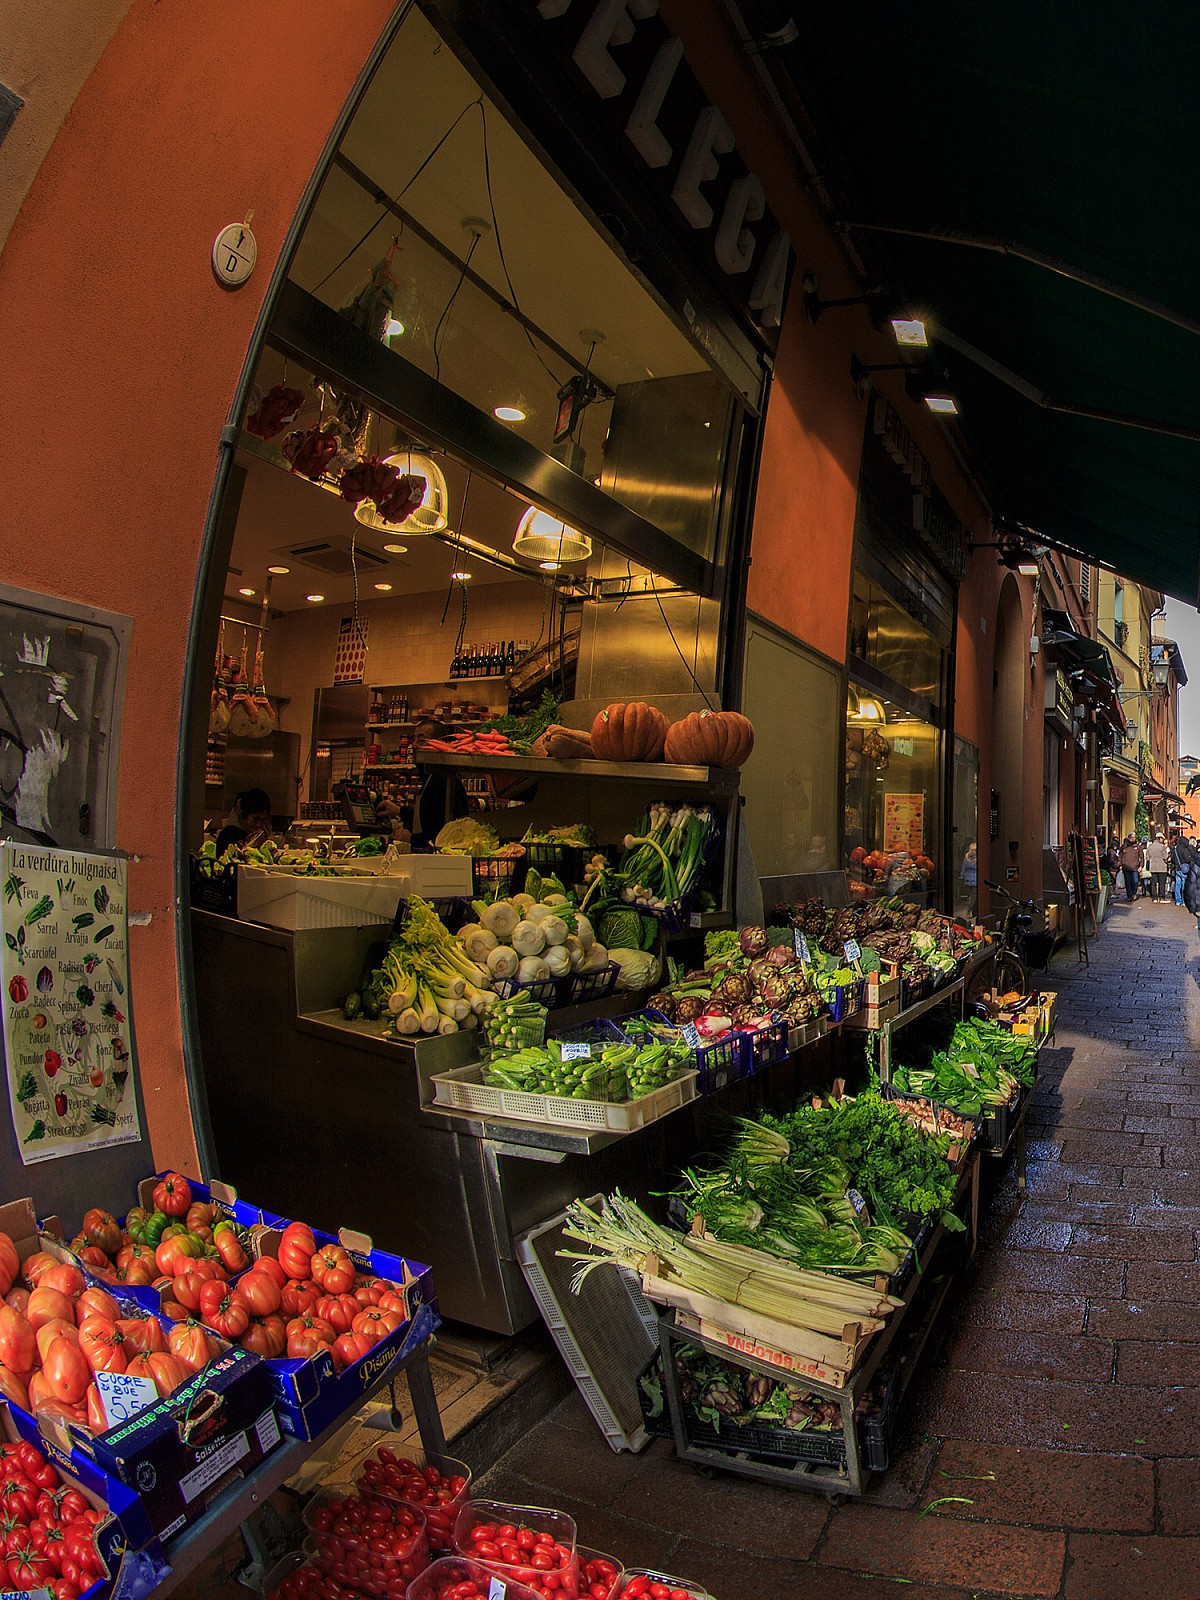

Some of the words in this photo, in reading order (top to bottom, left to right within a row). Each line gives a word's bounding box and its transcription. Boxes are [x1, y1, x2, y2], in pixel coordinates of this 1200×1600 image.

[536, 0, 791, 328] ELEGA
[12, 848, 25, 869] La
[71, 856, 117, 882] bulgnaisa
[359, 1345, 398, 1389] Pisana
[726, 1332, 793, 1370] BOLOGNA
[97, 1372, 147, 1388] CUORE
[112, 1385, 139, 1397] BUE
[105, 1412, 156, 1445] differenza
